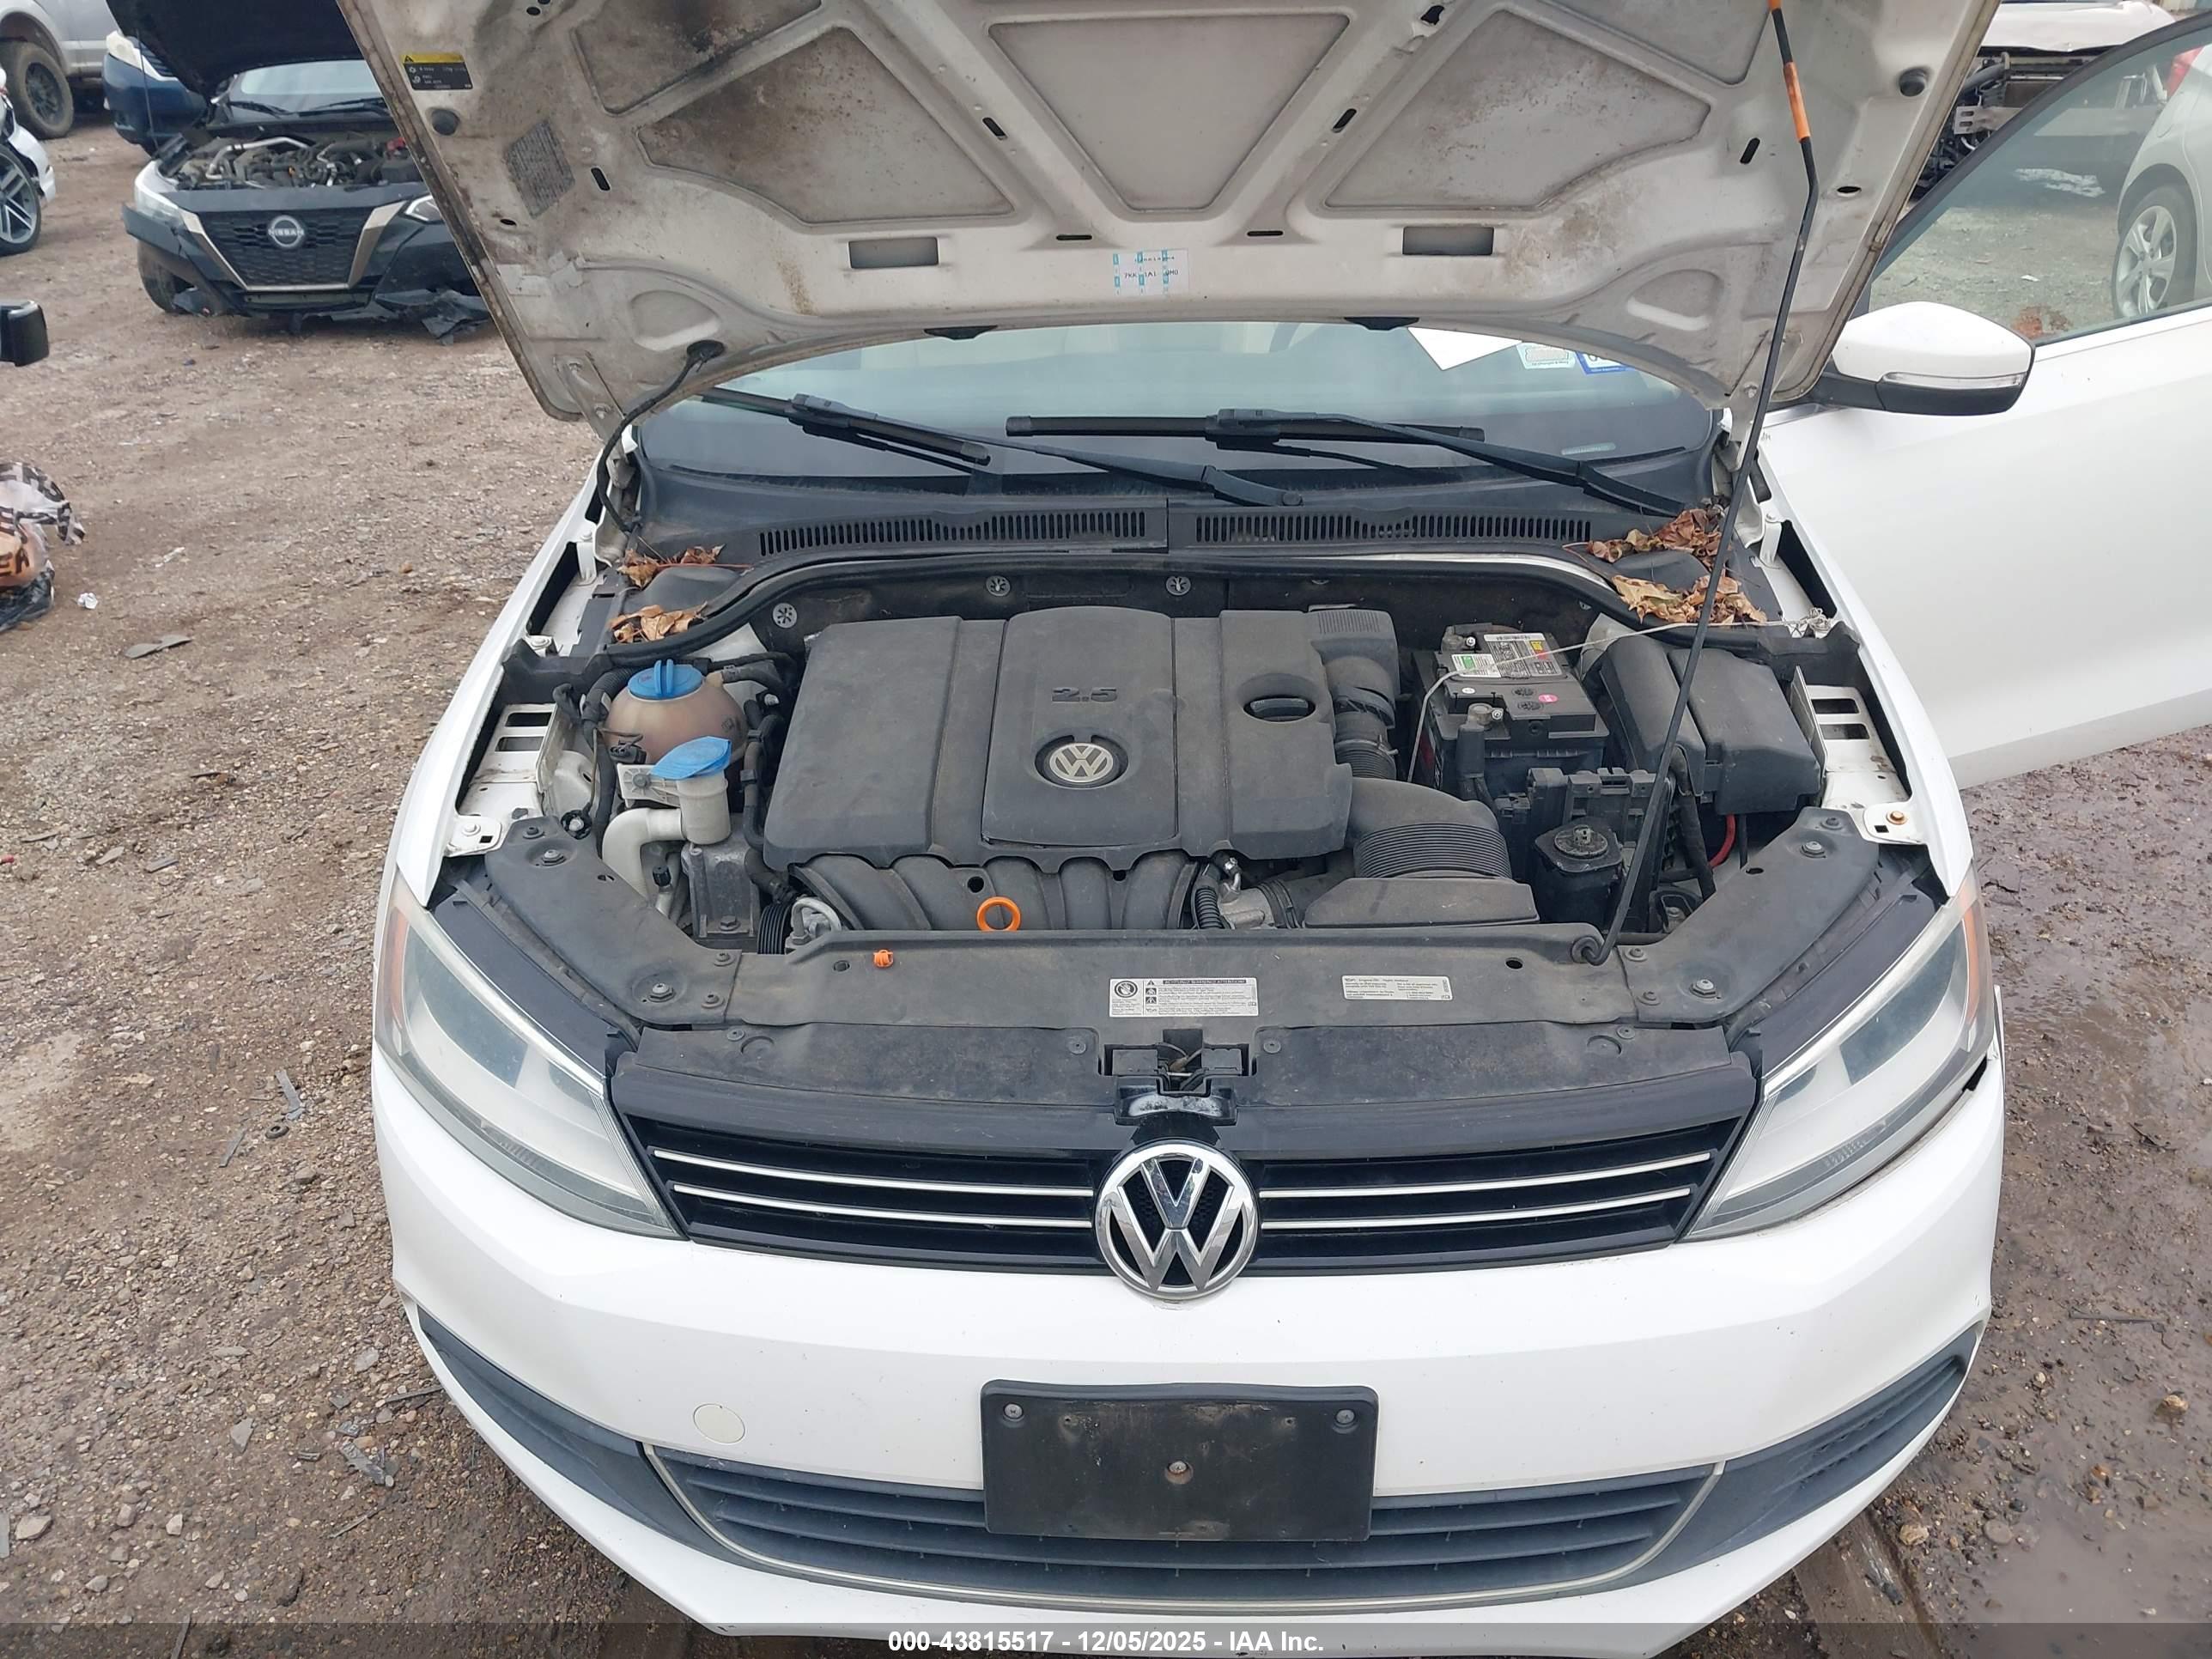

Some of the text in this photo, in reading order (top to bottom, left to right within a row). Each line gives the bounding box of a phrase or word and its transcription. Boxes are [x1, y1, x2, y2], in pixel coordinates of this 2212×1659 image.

[268, 228, 305, 236] NISSAN
[1051, 687, 1118, 702] 2.5
[1050, 744, 1113, 781] VW
[1100, 1150, 1254, 1295] VW
